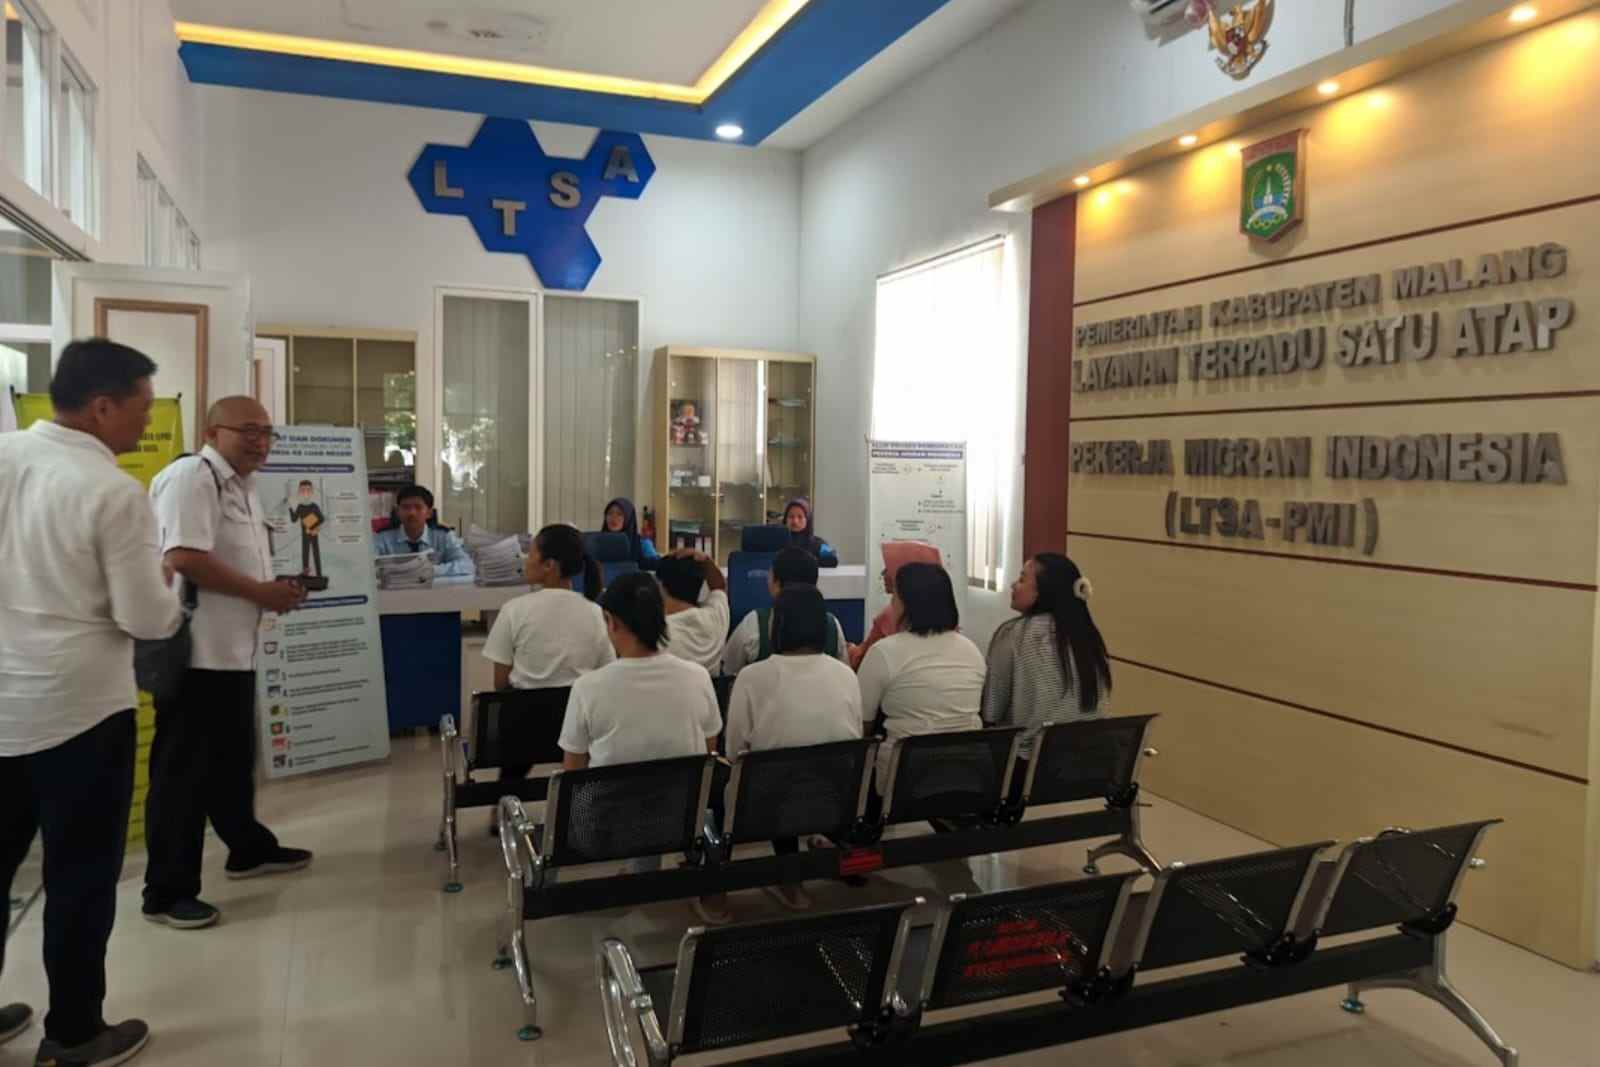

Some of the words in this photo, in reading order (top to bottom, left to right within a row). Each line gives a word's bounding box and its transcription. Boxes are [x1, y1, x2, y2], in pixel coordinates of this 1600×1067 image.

[1075, 305, 1202, 348] PEMERINTAH
[1209, 273, 1381, 329] KABUPATEN
[1391, 242, 1568, 300] MALANG
[1072, 347, 1178, 394] LAYANAN
[1185, 325, 1326, 381] TERPADU
[1335, 310, 1440, 368] SATU
[1453, 298, 1576, 358] ATAP
[1070, 439, 1175, 477] PEKERJA
[1184, 436, 1312, 478] MIGRAN
[1326, 432, 1568, 485] INDONESIA
